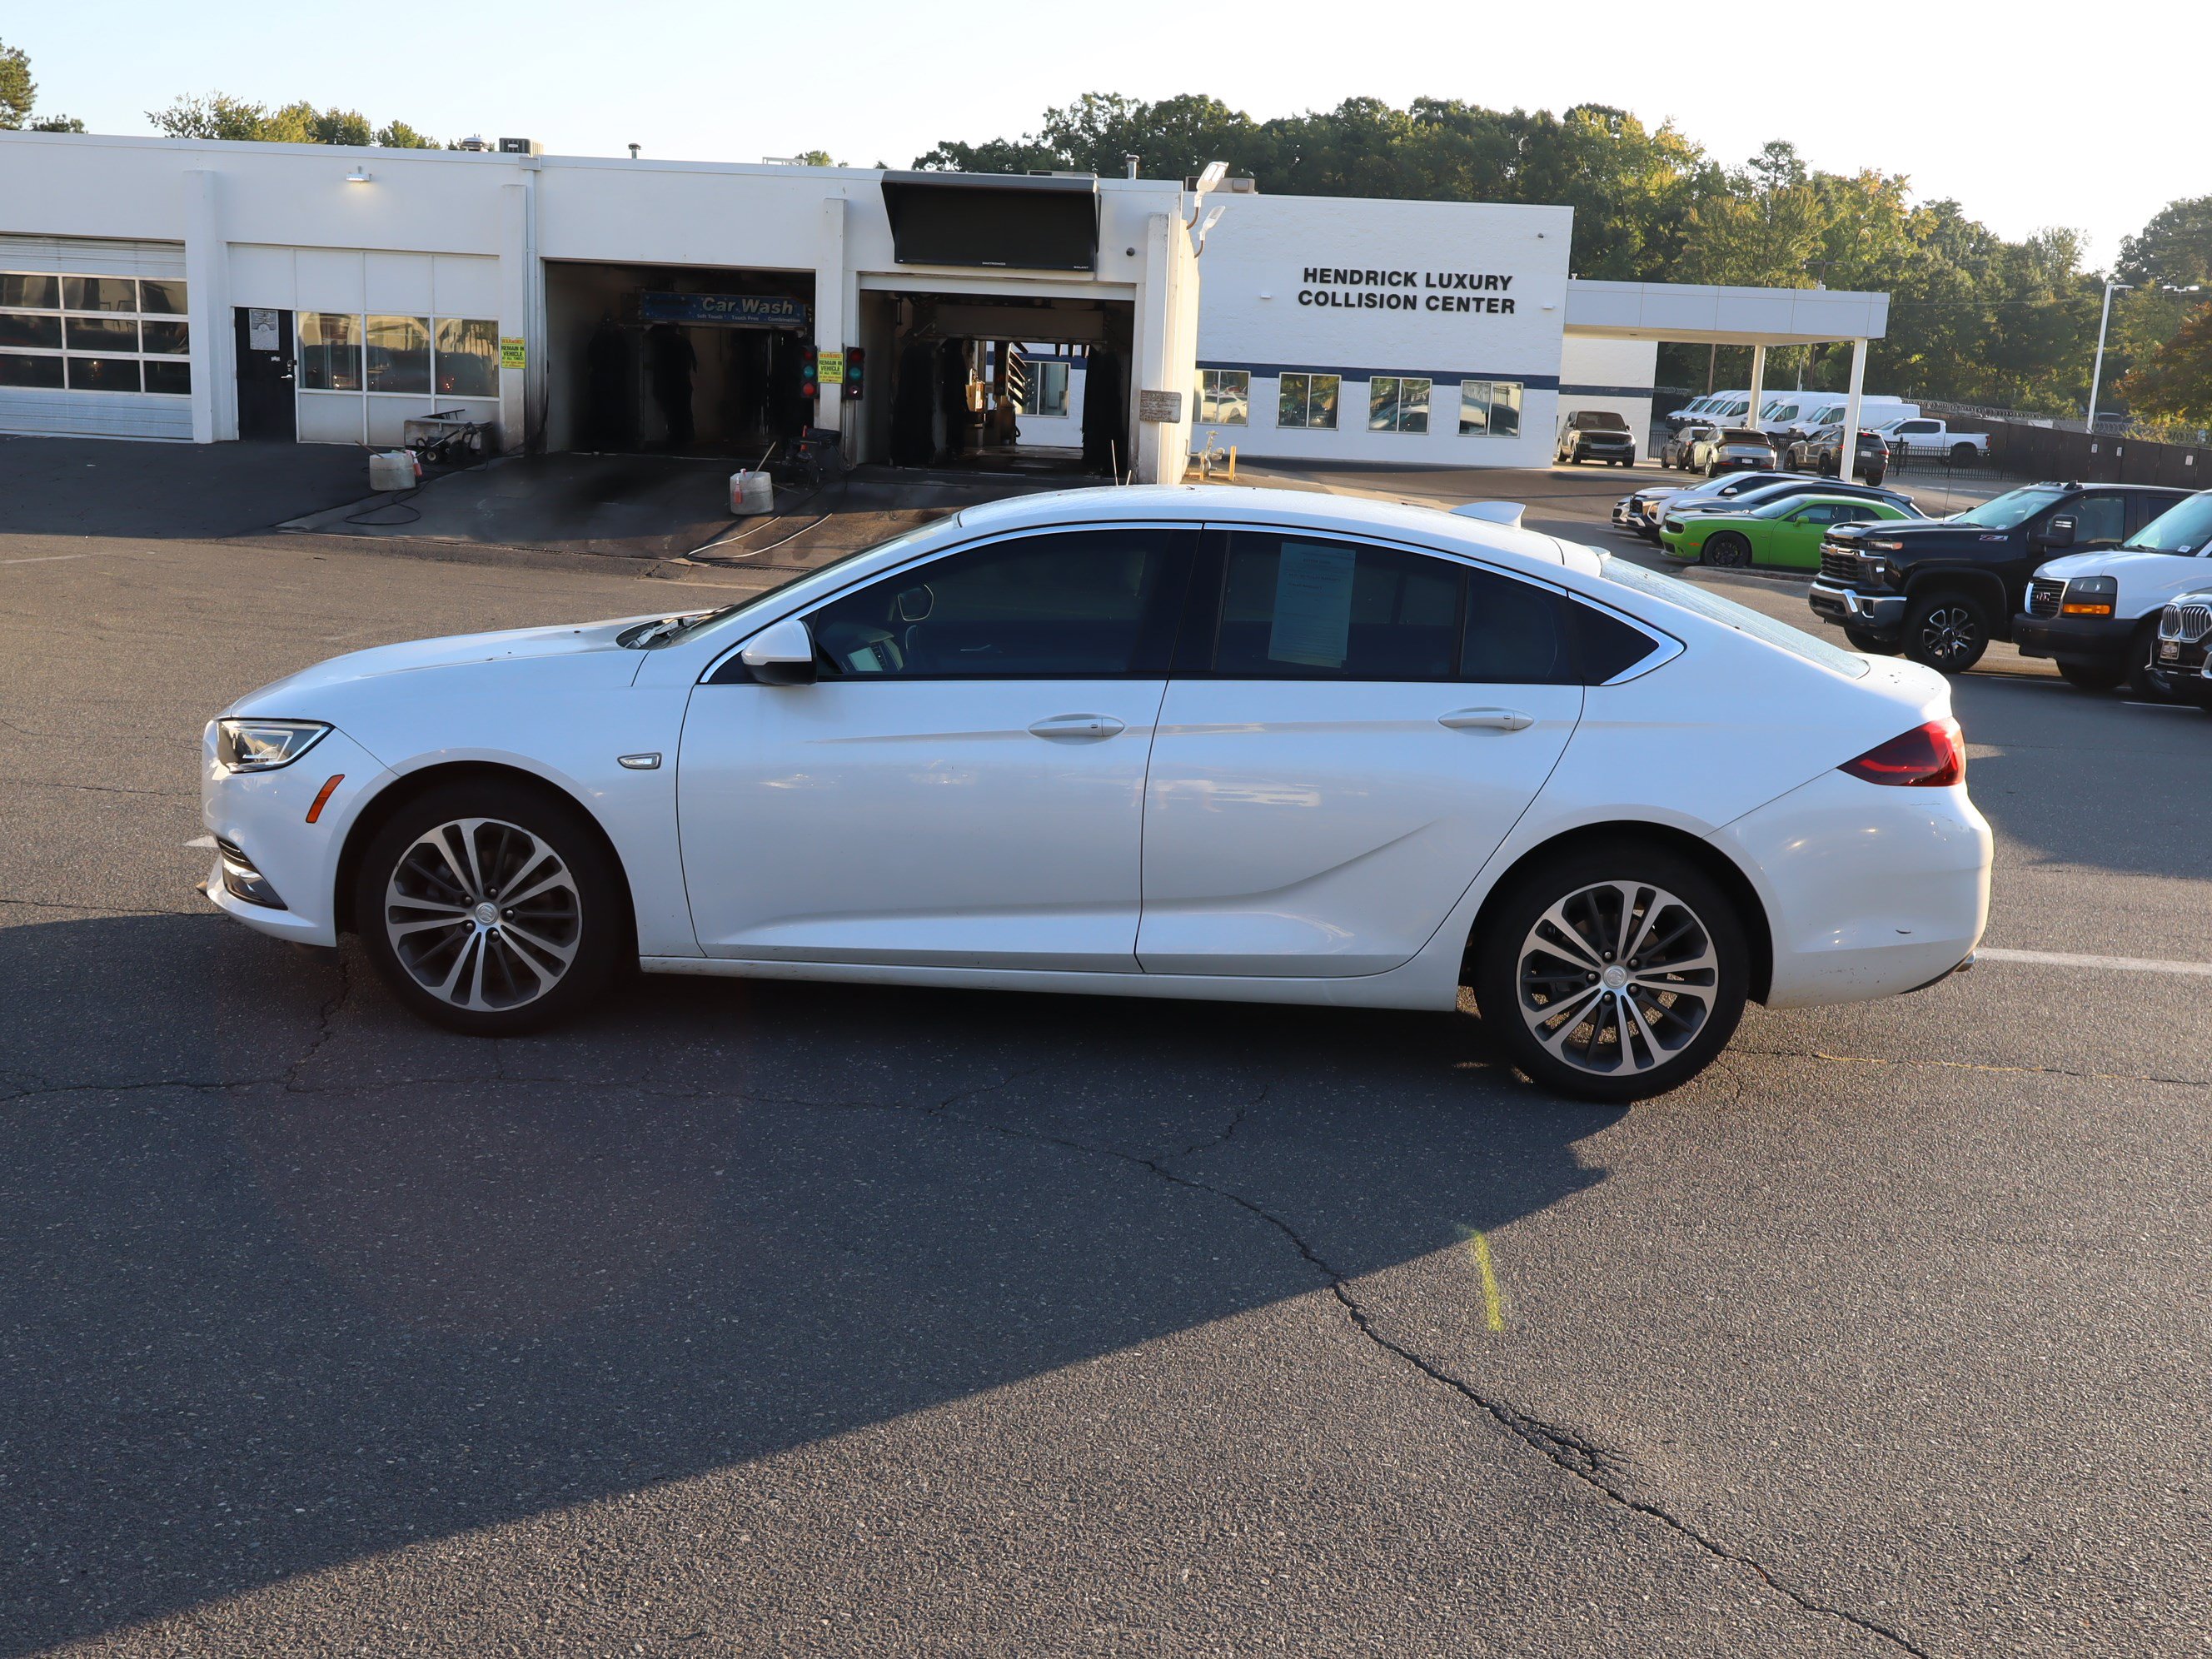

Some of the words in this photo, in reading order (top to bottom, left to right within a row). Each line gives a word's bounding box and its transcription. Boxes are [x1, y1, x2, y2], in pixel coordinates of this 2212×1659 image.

[1303, 267, 1417, 287] HENDRICK
[1425, 272, 1512, 291] LUXURY
[702, 296, 736, 312] Car
[741, 298, 794, 315] Wash
[1298, 290, 1417, 310] COLLISION
[1425, 295, 1515, 314] CENTER
